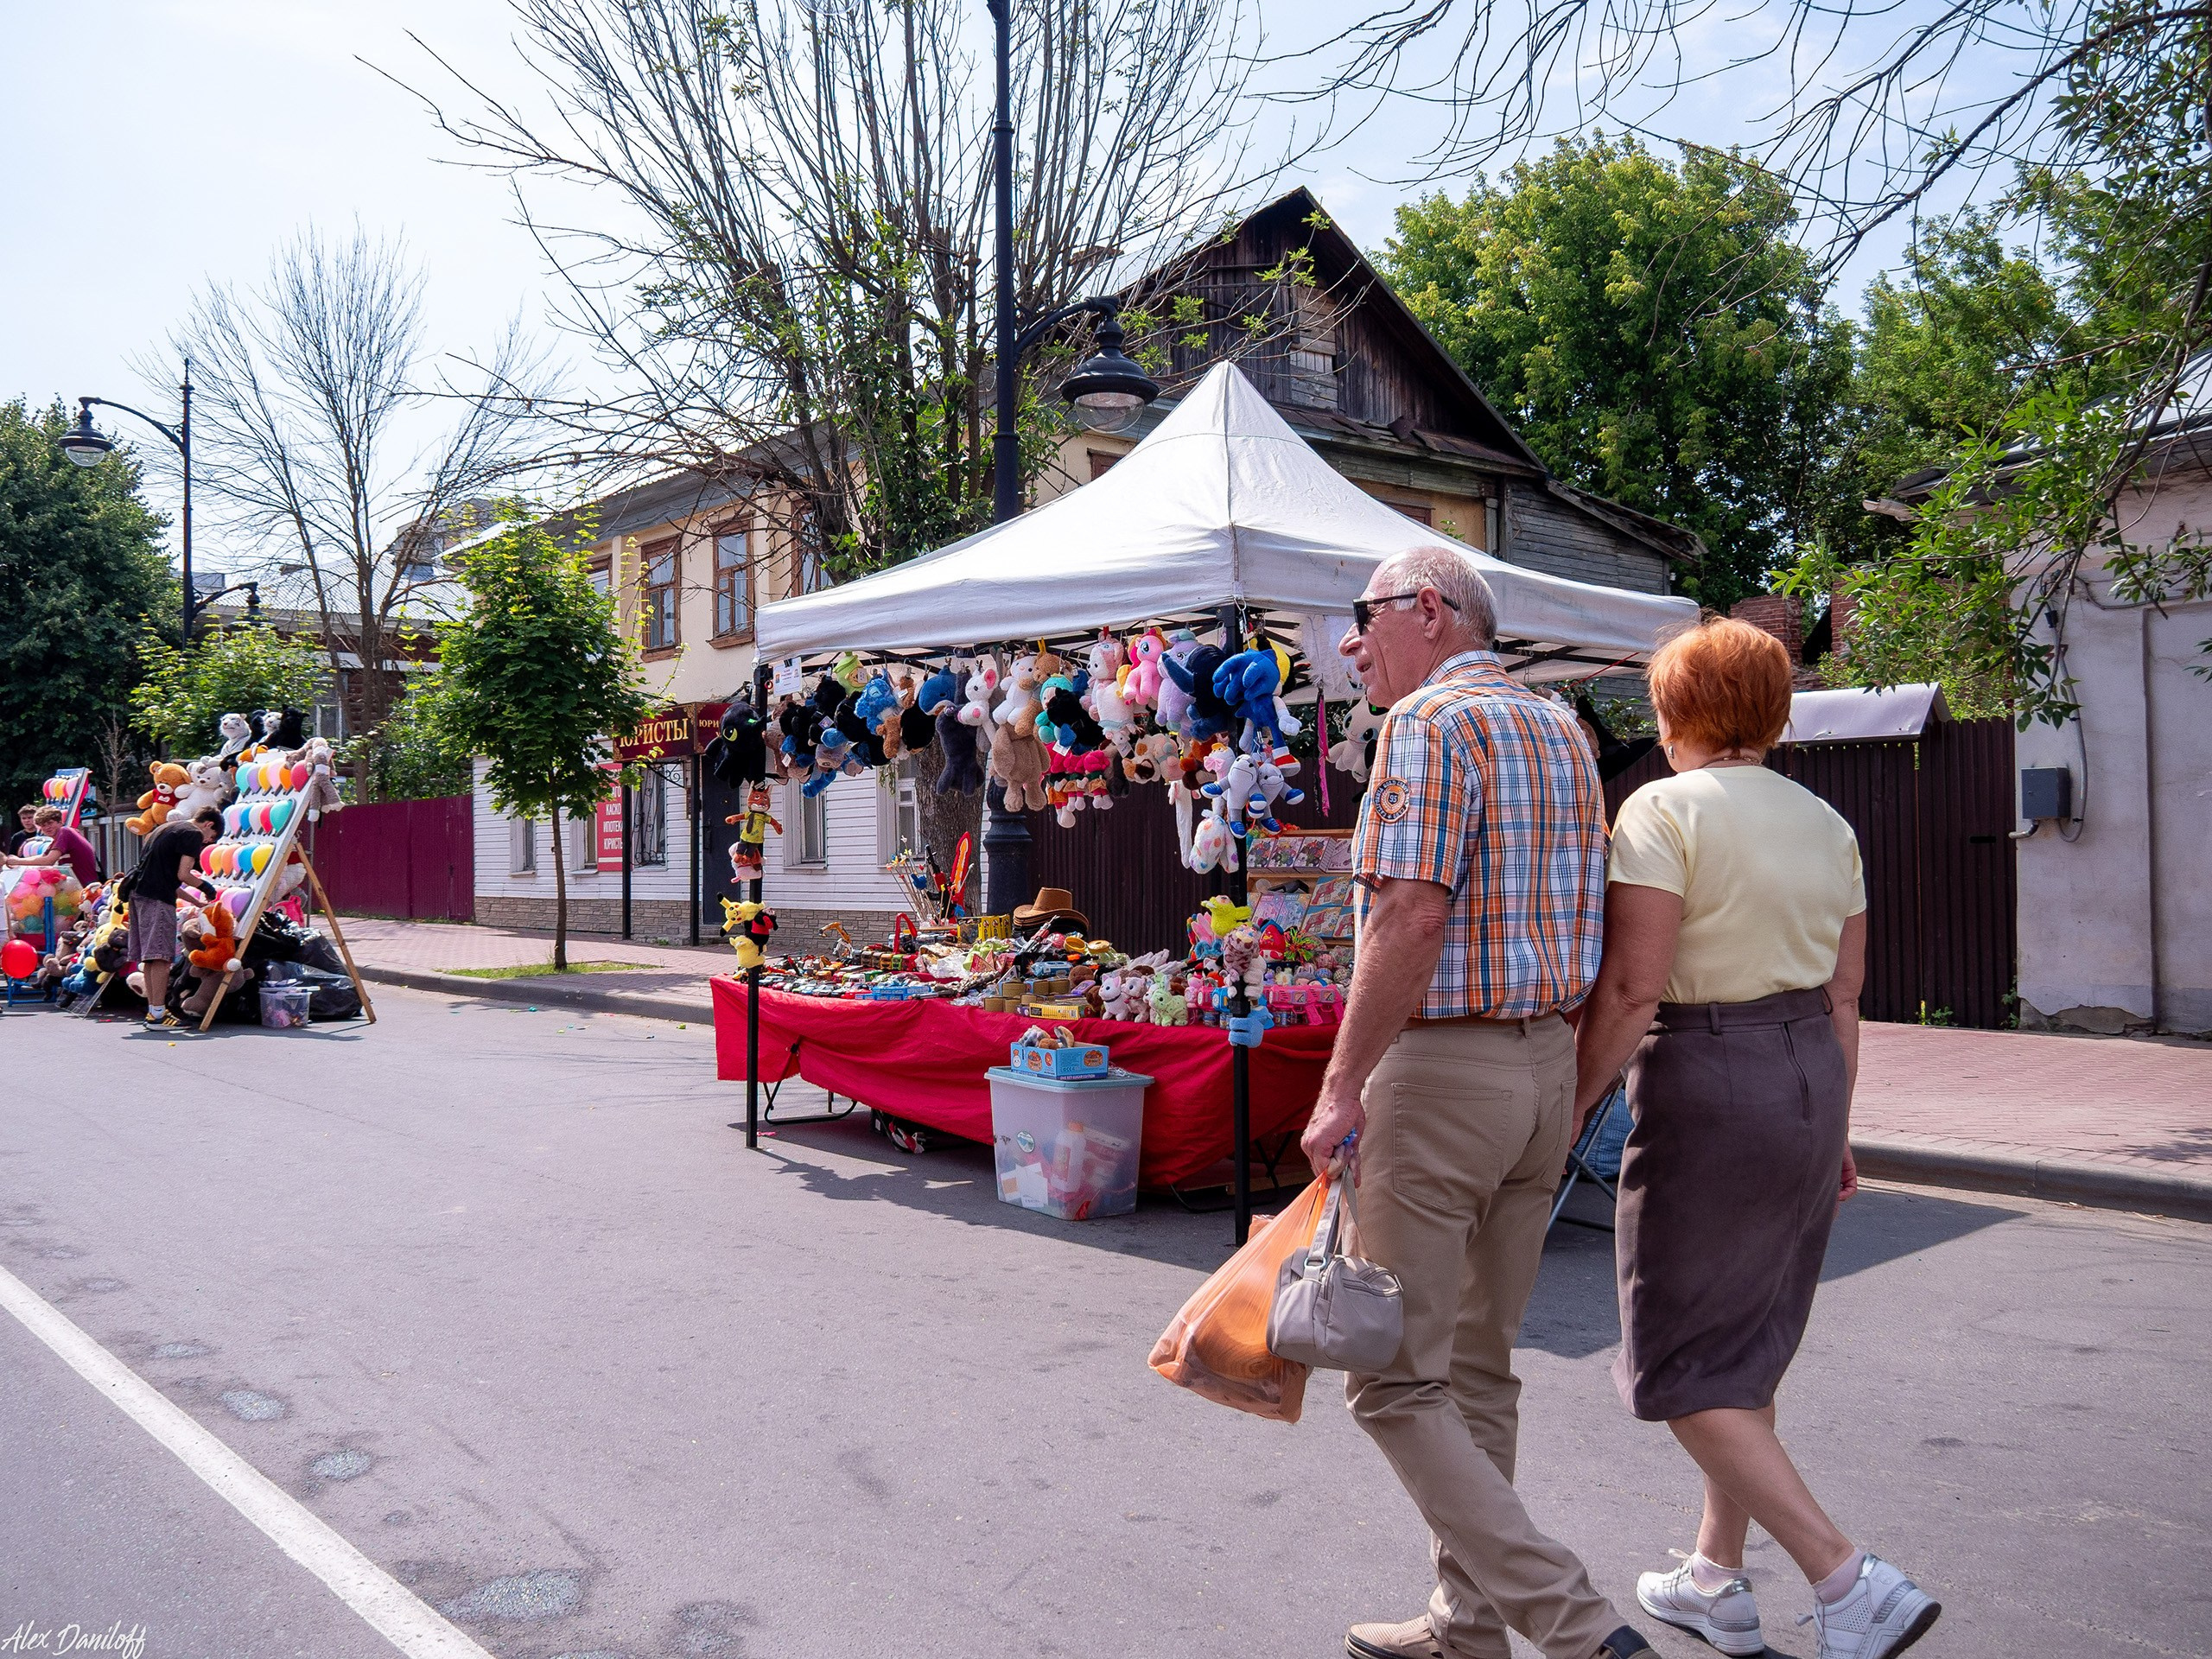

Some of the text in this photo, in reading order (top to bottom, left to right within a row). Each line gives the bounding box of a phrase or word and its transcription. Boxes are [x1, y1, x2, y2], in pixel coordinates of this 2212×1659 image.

[699, 719, 720, 728] ЮРИ
[606, 803, 621, 816] КАСКО
[603, 820, 623, 833] ИПОТЕК
